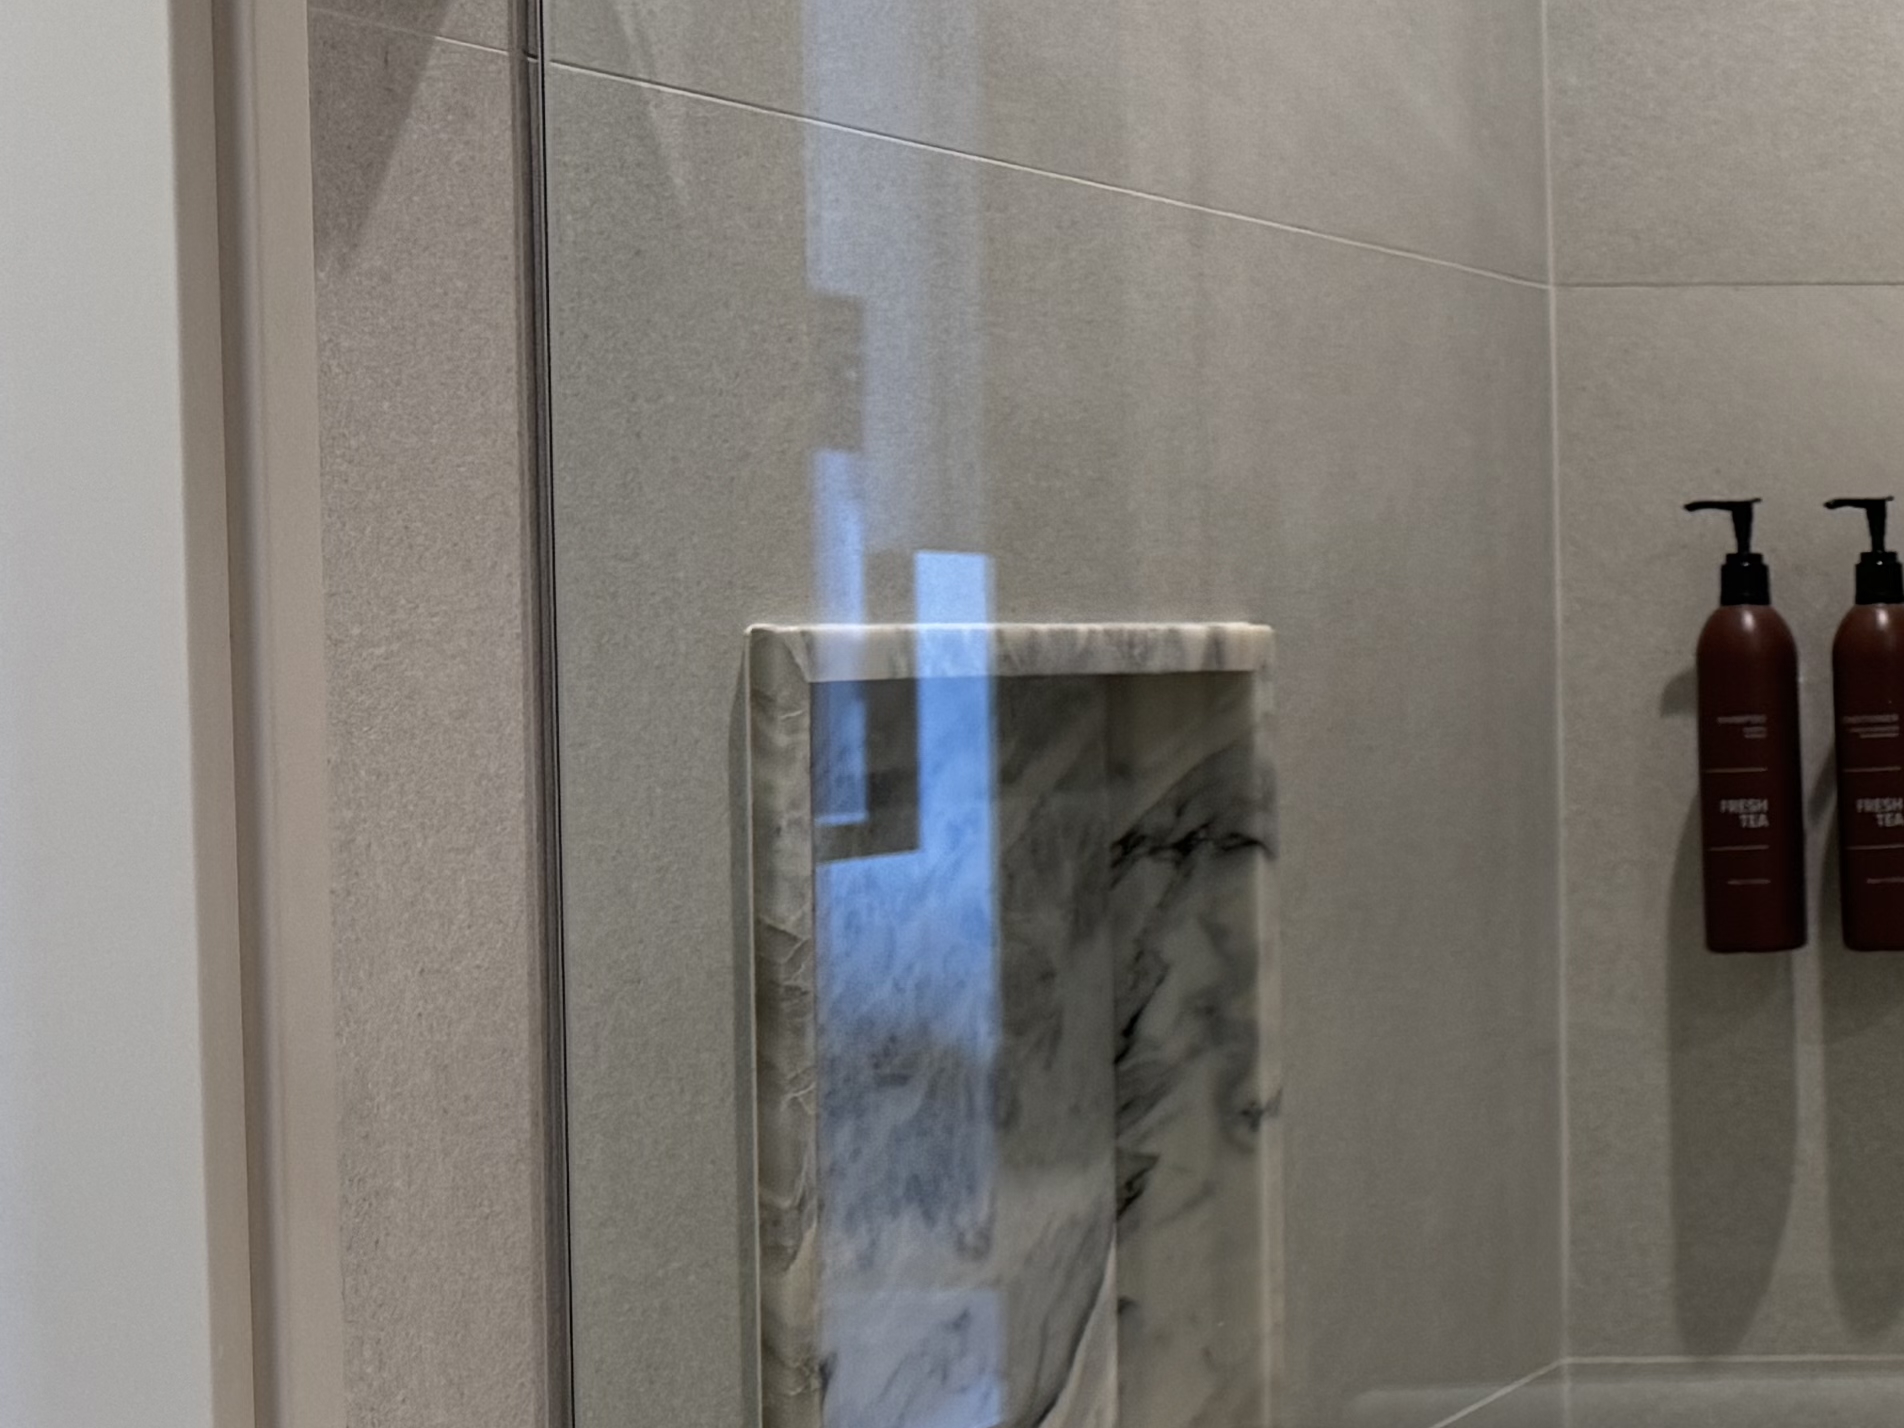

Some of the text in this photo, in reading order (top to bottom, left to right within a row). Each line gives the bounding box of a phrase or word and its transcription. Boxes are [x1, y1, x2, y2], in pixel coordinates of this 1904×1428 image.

[1719, 798, 1769, 814] FRESH
[1855, 796, 1904, 813] FRESH
[1738, 813, 1770, 829] TEA
[1875, 812, 1904, 827] TEA
